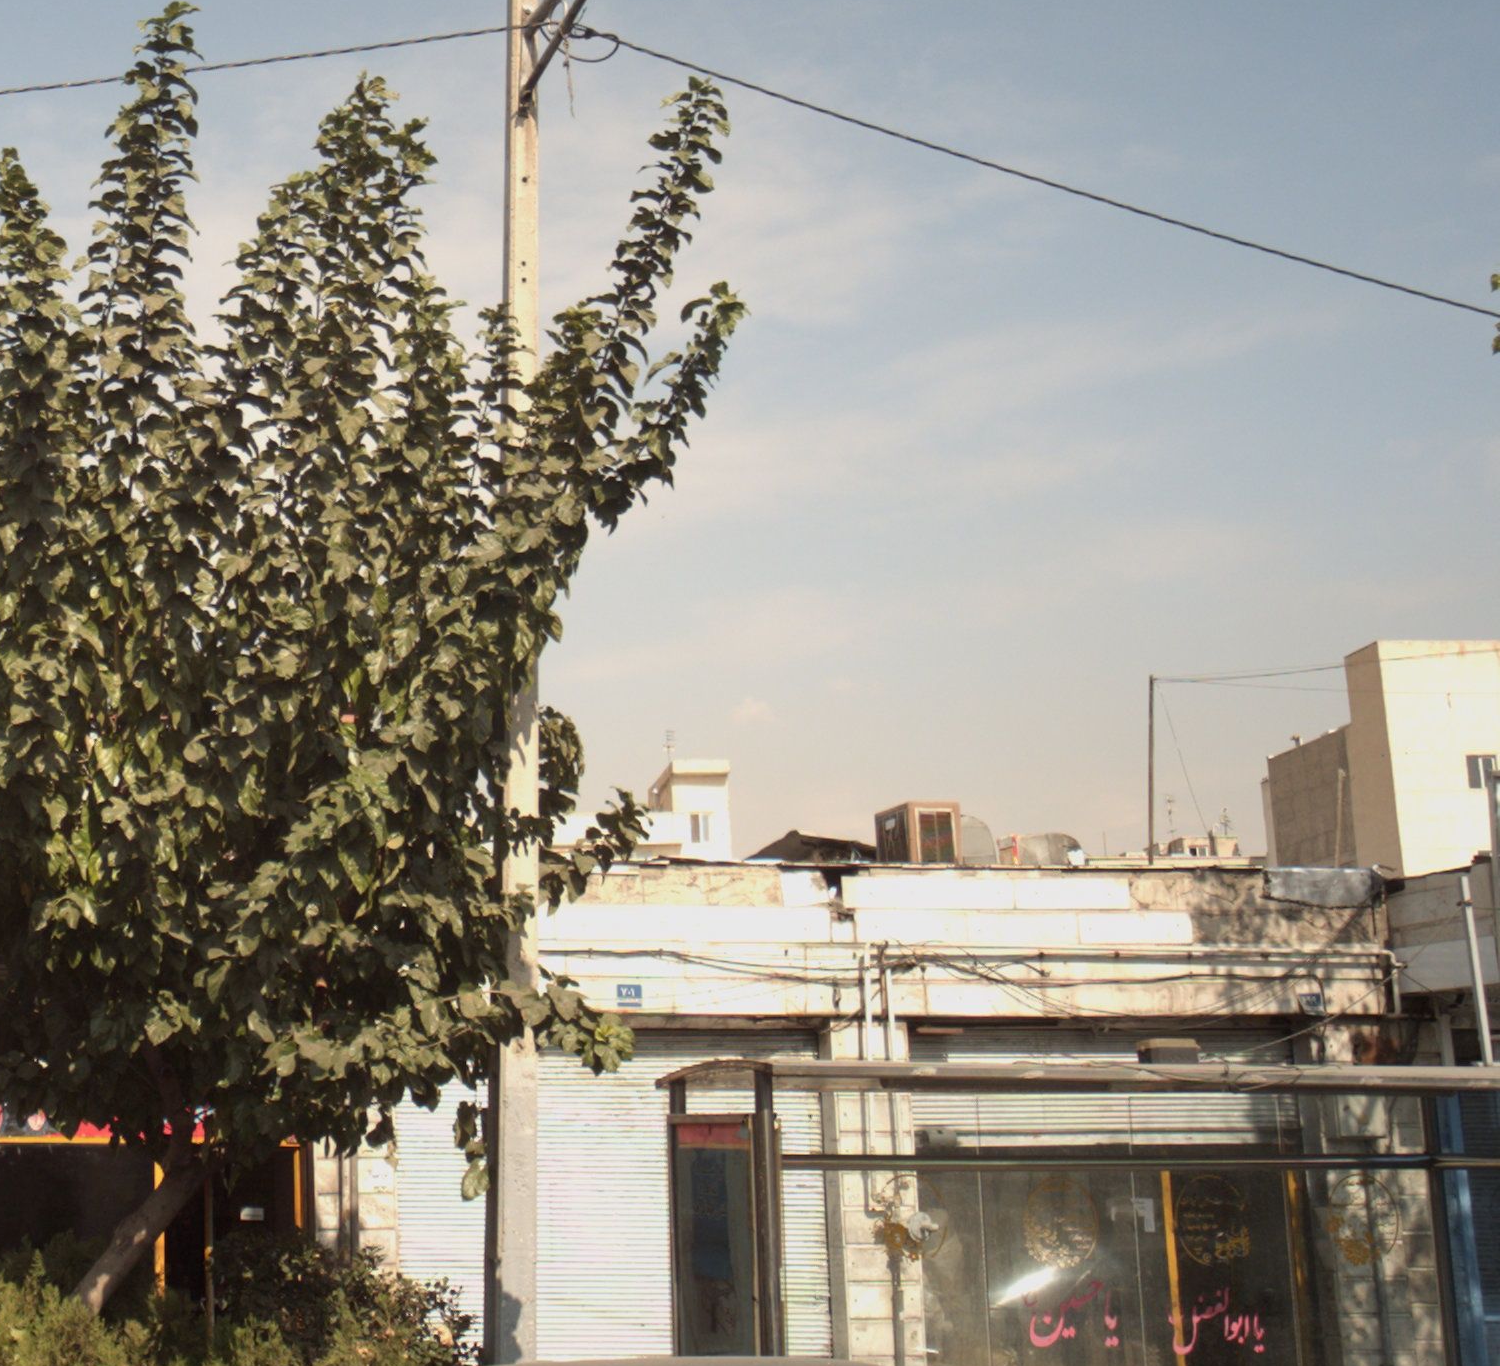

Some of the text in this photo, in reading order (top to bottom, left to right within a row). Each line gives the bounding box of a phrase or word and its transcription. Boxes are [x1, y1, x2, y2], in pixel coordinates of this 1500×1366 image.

[1029, 1281, 1119, 1348] یا حسین
[1253, 1308, 1265, 1353] یا
